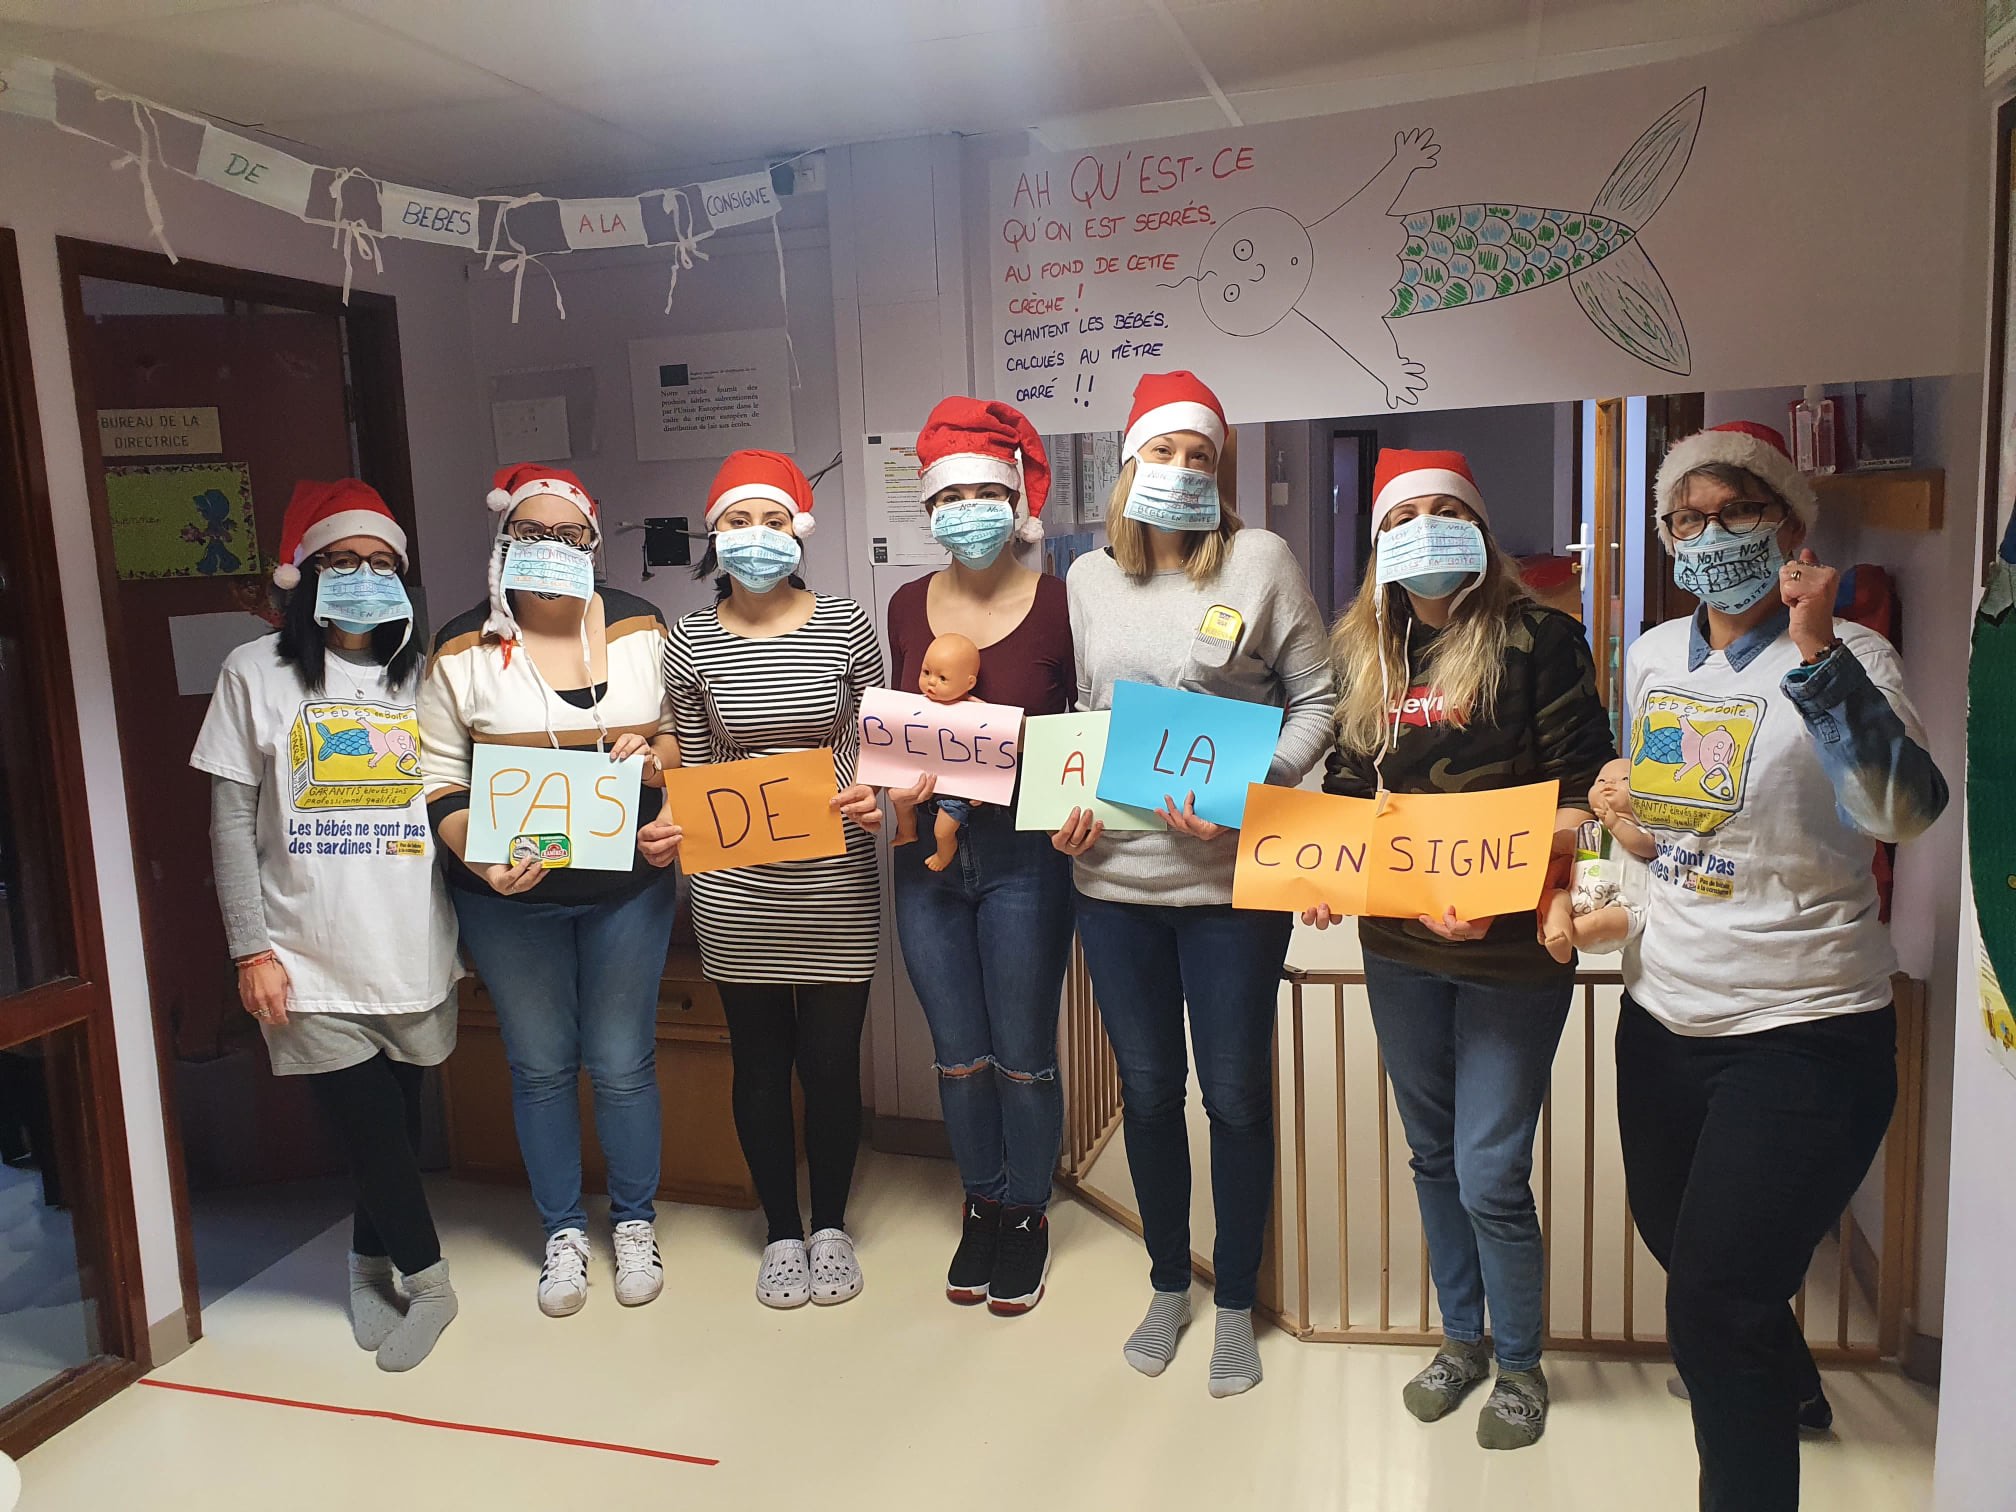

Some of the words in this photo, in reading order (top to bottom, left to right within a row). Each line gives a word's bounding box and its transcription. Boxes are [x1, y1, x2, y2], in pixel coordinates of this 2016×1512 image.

[224, 152, 271, 184] DE
[402, 201, 473, 235] BEBES
[579, 213, 595, 234] A
[600, 213, 627, 234] LA
[706, 186, 771, 217] CONSIGNE
[1013, 170, 1051, 208] AH
[1003, 216, 1072, 252] QU'ON
[1085, 216, 1126, 239] EST
[1005, 264, 1031, 284] AU
[1041, 259, 1084, 280] FOND
[1094, 257, 1120, 275] DE
[1127, 253, 1180, 271] CETTE
[1004, 321, 1070, 346] CHANTENT
[1079, 316, 1105, 334] LES
[1080, 348, 1100, 365] AU
[1111, 338, 1164, 360] MÈTRE
[1016, 377, 1058, 402] CARRÉ
[101, 415, 153, 428] BUREAU
[160, 415, 176, 427] DE
[183, 415, 200, 427] LA
[114, 435, 190, 449] DIRECTRICE
[312, 706, 370, 719] Bébés
[863, 711, 1016, 770] BÉBÉS
[1152, 728, 1217, 785] LA
[489, 768, 627, 838] PAS
[707, 776, 811, 849] DE
[288, 818, 312, 836] Les
[315, 818, 352, 836] bébés
[355, 823, 370, 836] ne
[373, 821, 400, 837] sont
[404, 823, 426, 839] pas
[288, 837, 312, 854] des
[317, 838, 372, 855] sardines
[1673, 846, 1706, 867] sont
[1705, 854, 1735, 876] pas
